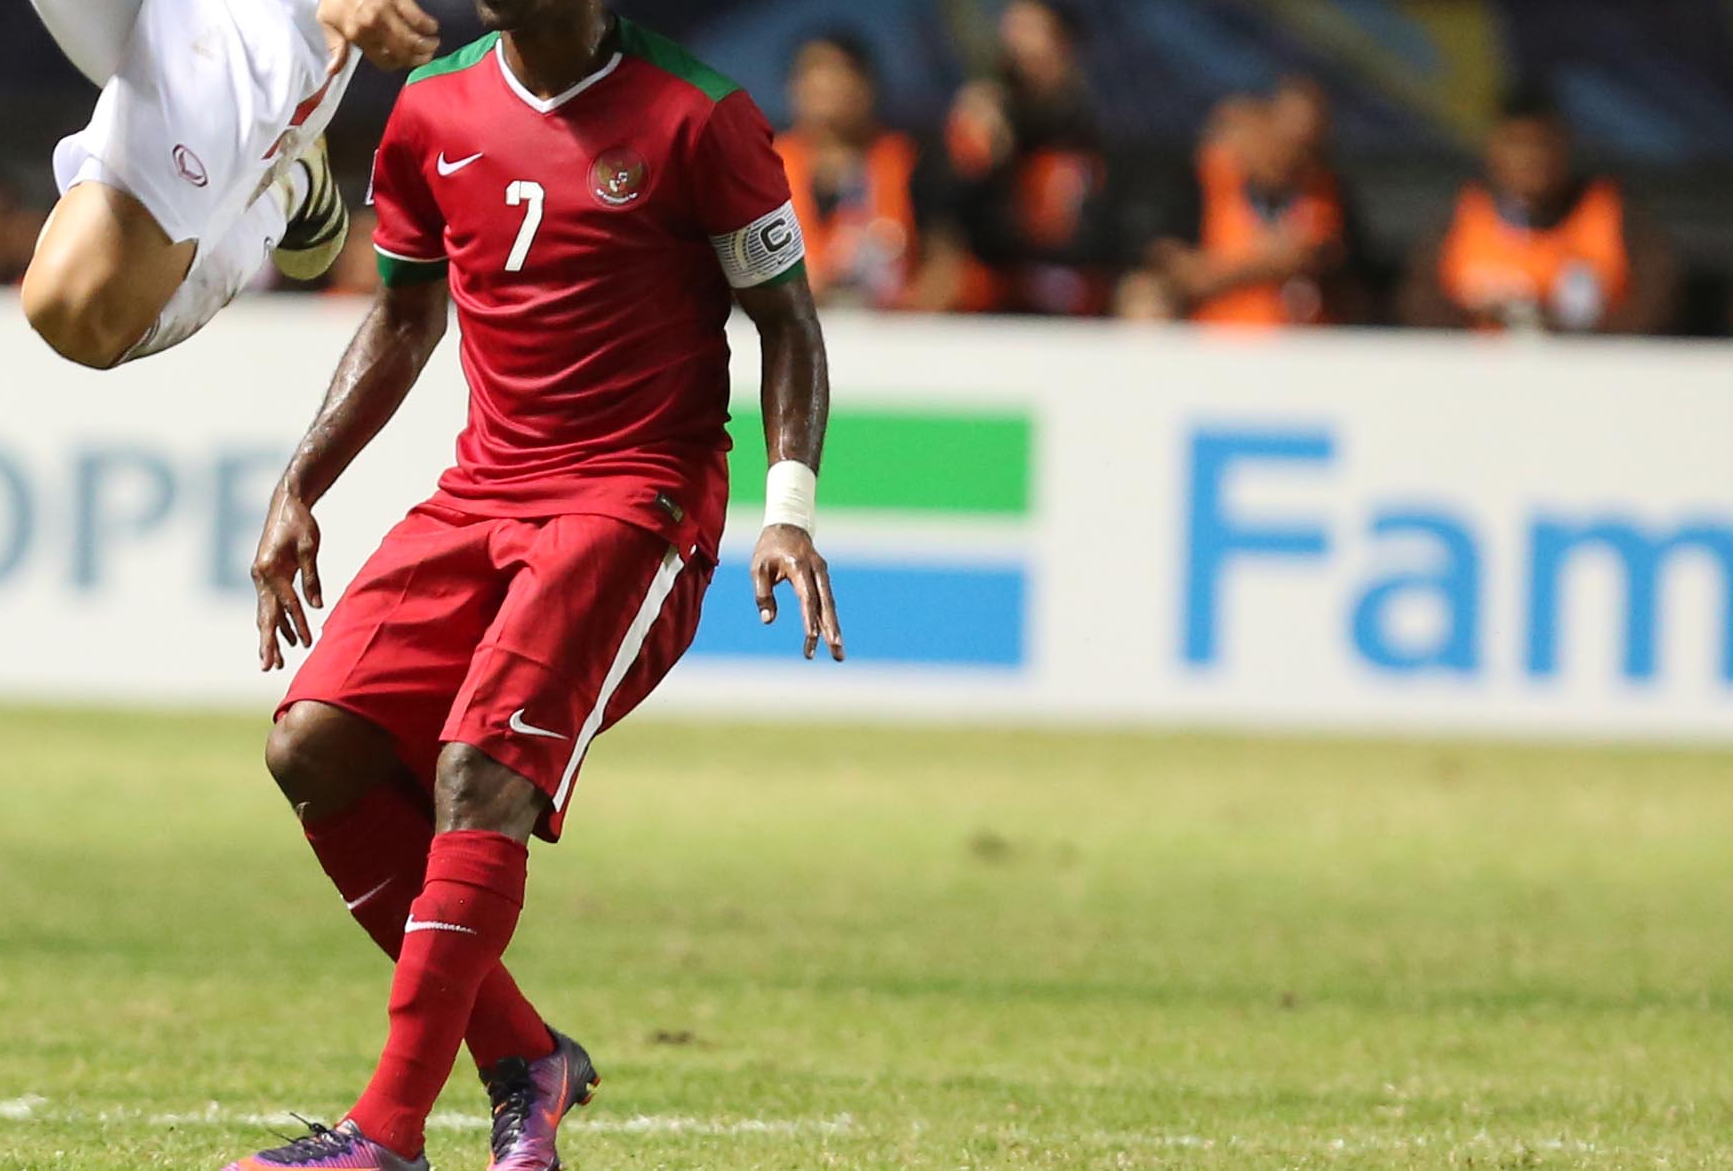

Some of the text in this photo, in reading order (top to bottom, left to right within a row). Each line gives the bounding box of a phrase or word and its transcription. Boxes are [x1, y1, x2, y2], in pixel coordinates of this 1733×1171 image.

[504, 180, 545, 271] 7
[759, 217, 793, 253] C
[1176, 425, 1733, 686] Fam
